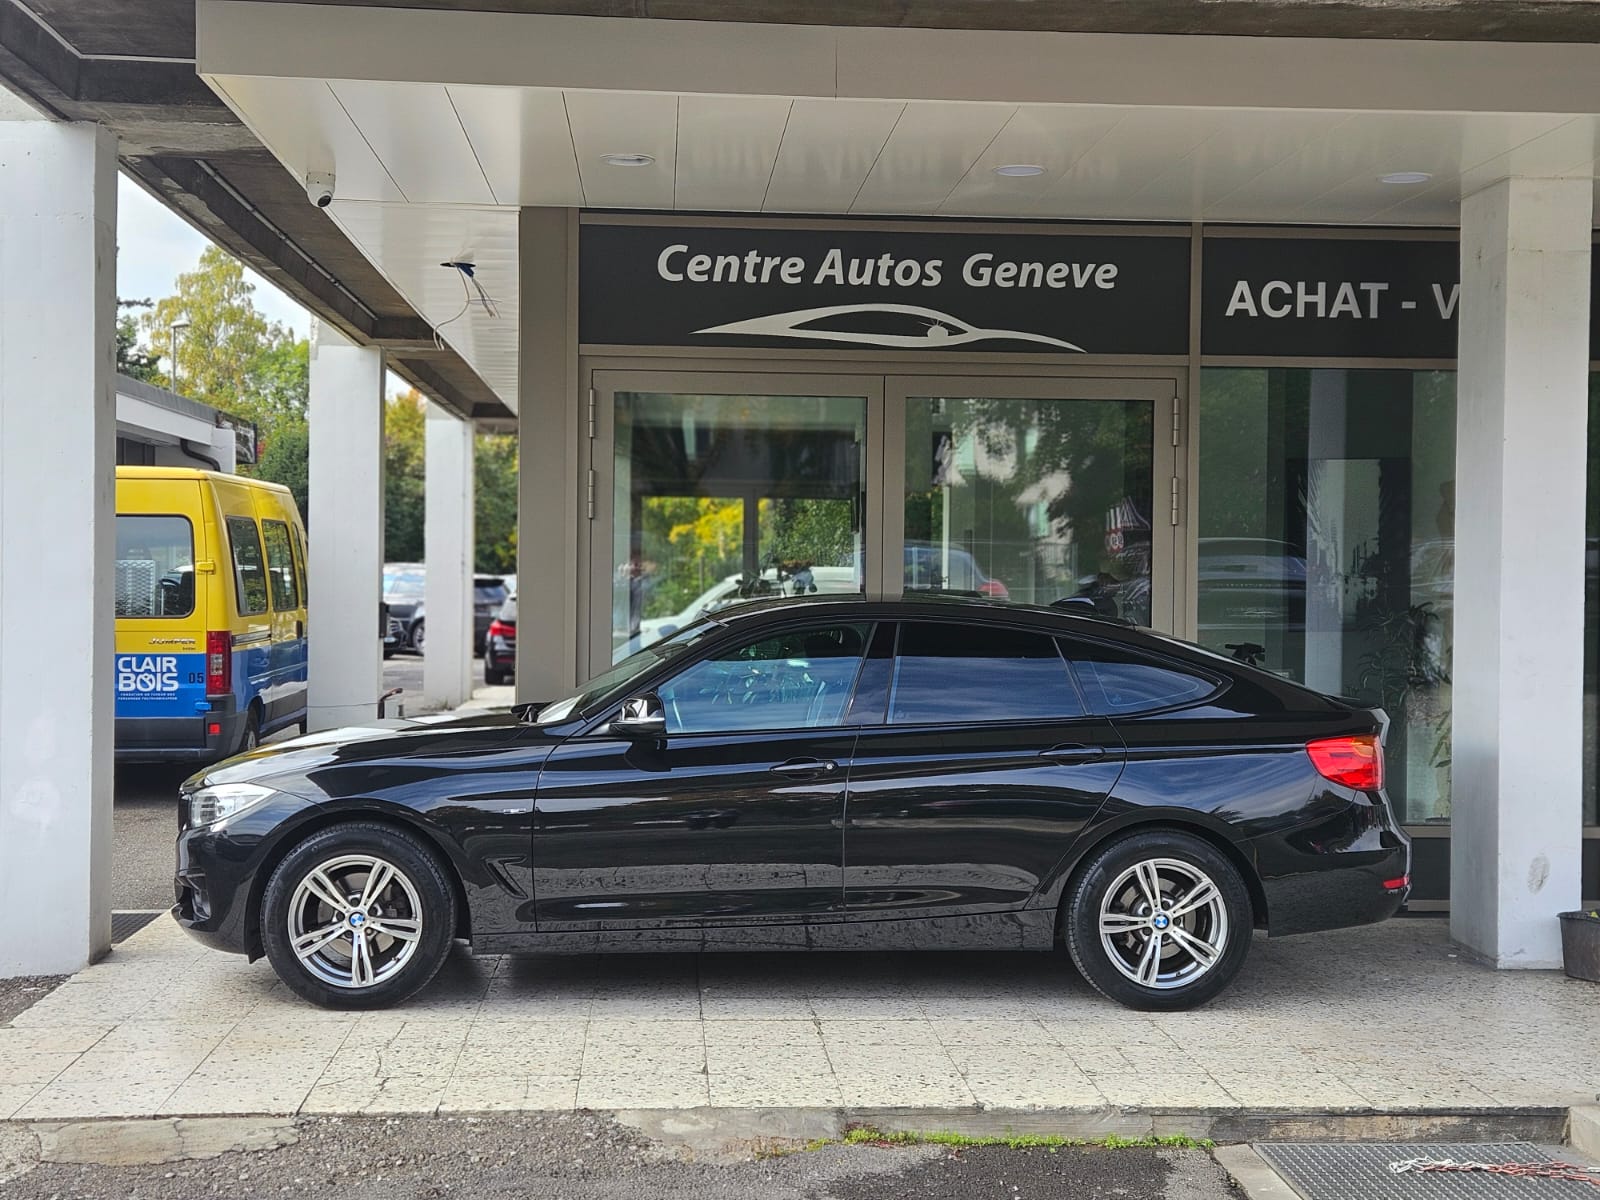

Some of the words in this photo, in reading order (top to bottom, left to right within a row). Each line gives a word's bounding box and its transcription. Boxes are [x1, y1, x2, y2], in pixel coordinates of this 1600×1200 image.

[657, 244, 804, 283] Centre
[813, 248, 943, 286] Autos
[962, 253, 1119, 289] Geneve
[1225, 280, 1389, 319] ACHAT
[117, 656, 177, 673] CLAIR
[118, 673, 179, 692] BOIS
[188, 672, 204, 684] 05
